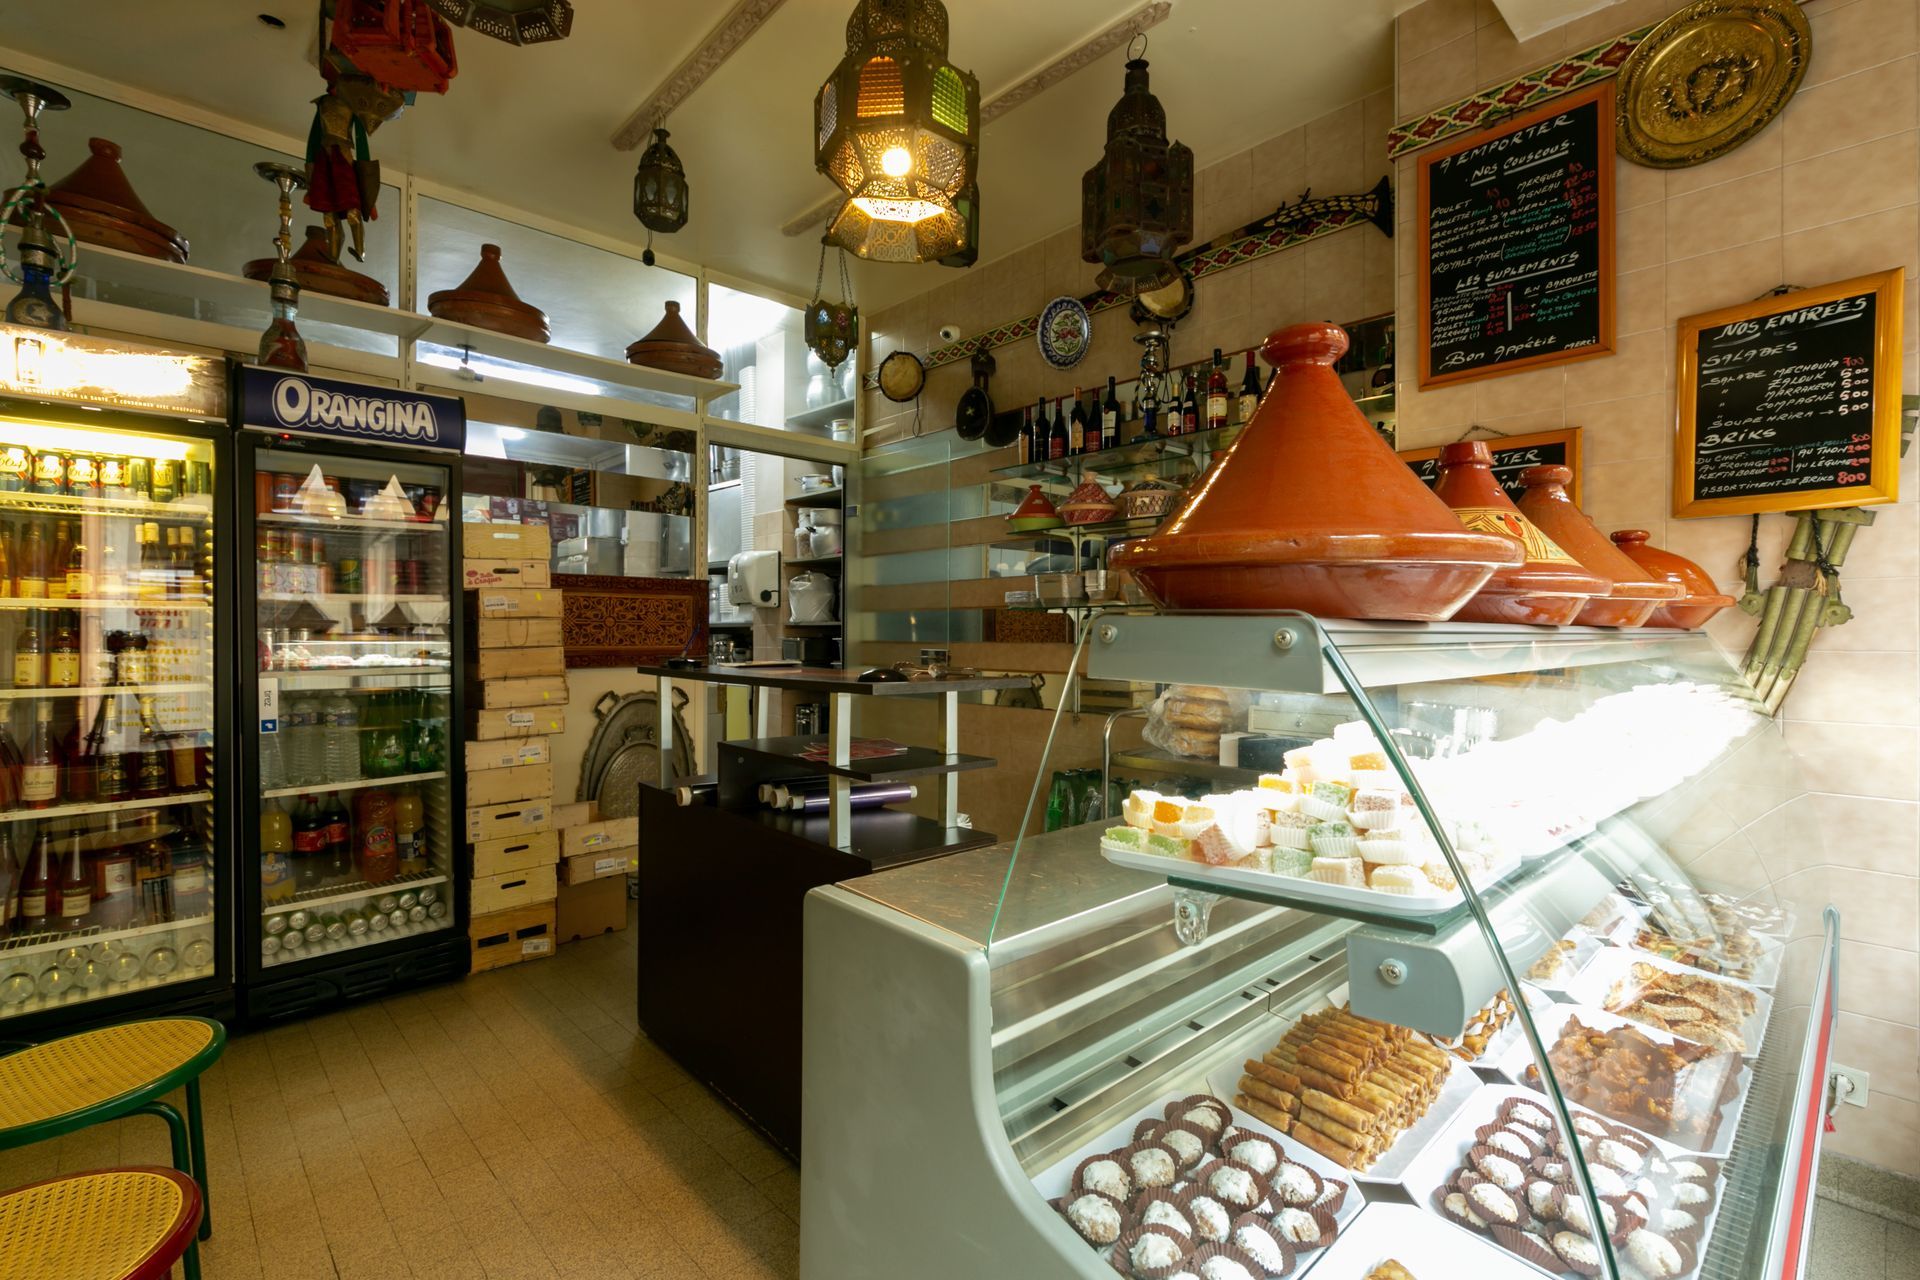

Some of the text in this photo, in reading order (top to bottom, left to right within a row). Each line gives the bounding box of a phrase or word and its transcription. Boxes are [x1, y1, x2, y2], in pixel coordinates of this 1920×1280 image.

[1456, 114, 1575, 167] EMPORTER
[1517, 181, 1561, 206] AGNEAU
[1431, 199, 1473, 219] POULET
[1432, 255, 1474, 275] ROYALE
[1456, 251, 1580, 292] LES SUPLEMENTS
[1713, 320, 1760, 341] NOS
[1439, 349, 1486, 371] Bon
[1701, 342, 1799, 368] SALADES
[1701, 370, 1767, 389] SALADE
[1764, 380, 1836, 400] MARRAKECH
[273, 378, 437, 441] ORANGINA
[1756, 391, 1834, 413] COMPAGNE
[1707, 415, 1763, 430] SOUPE
[1490, 448, 1542, 466] RTER
[1696, 456, 1712, 465] DU
[1797, 448, 1813, 458] AU
[1816, 445, 1848, 456] THON
[1697, 470, 1735, 481] KEFTA
[1698, 464, 1715, 474] AU
[1717, 459, 1770, 473] FROMAGE
[1795, 462, 1809, 473] AU
[1784, 476, 1799, 485] DE
[1836, 471, 1867, 485] 800
